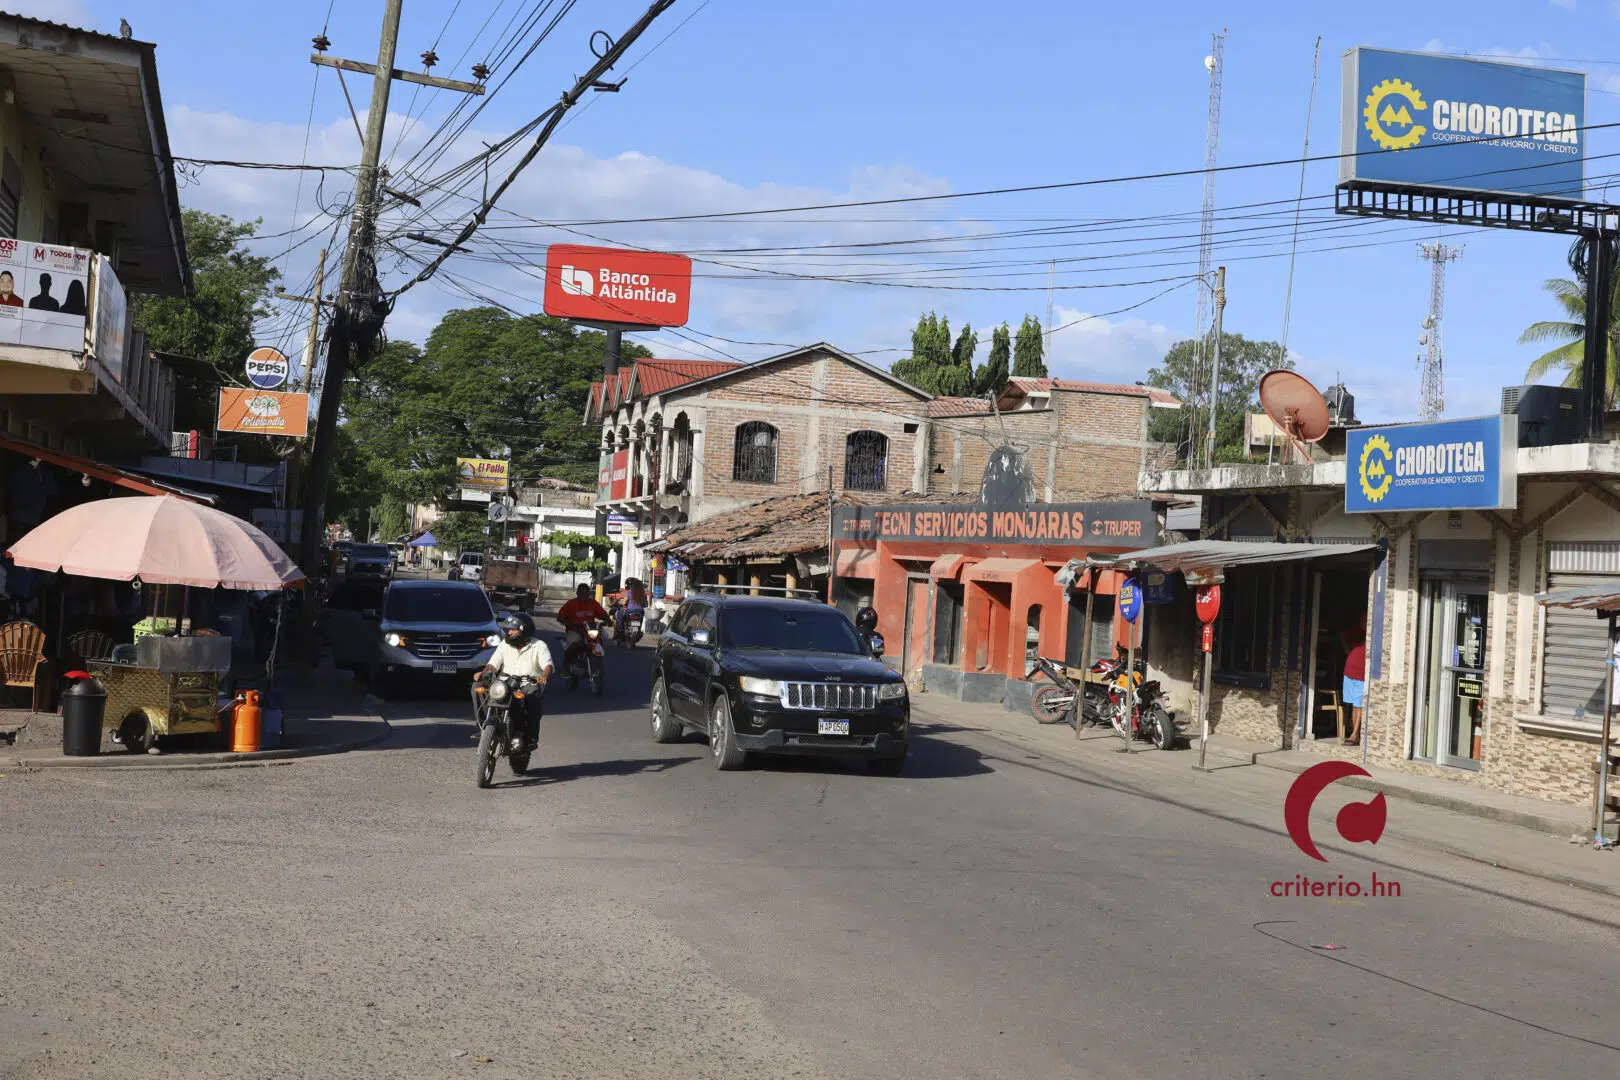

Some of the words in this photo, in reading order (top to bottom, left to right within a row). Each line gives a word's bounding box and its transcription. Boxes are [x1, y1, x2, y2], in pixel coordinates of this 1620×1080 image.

[1432, 99, 1578, 144] CHOROTEGA
[1432, 131, 1488, 145] COOPERATIVA
[1489, 138, 1500, 146] DE
[1501, 139, 1535, 150] AHORRO
[1543, 144, 1578, 154] CREDITO
[50, 249, 72, 259] TODOS
[599, 268, 650, 286] Banco
[599, 283, 676, 304] Atlántida
[248, 361, 285, 374] PEPSI
[1395, 441, 1485, 477] CHOROTEGA
[486, 463, 505, 474] Pollo
[1395, 477, 1428, 487] COOPERATIVA
[1428, 477, 1435, 485] DE
[1435, 475, 1457, 484] AHORRO
[1462, 474, 1485, 483] CREDITO
[850, 519, 872, 532] TRUPER
[874, 511, 911, 536] TECNI
[915, 511, 988, 537] SERVICIOS
[992, 511, 1084, 540] MONJARAS
[1103, 520, 1142, 537] TRUPER
